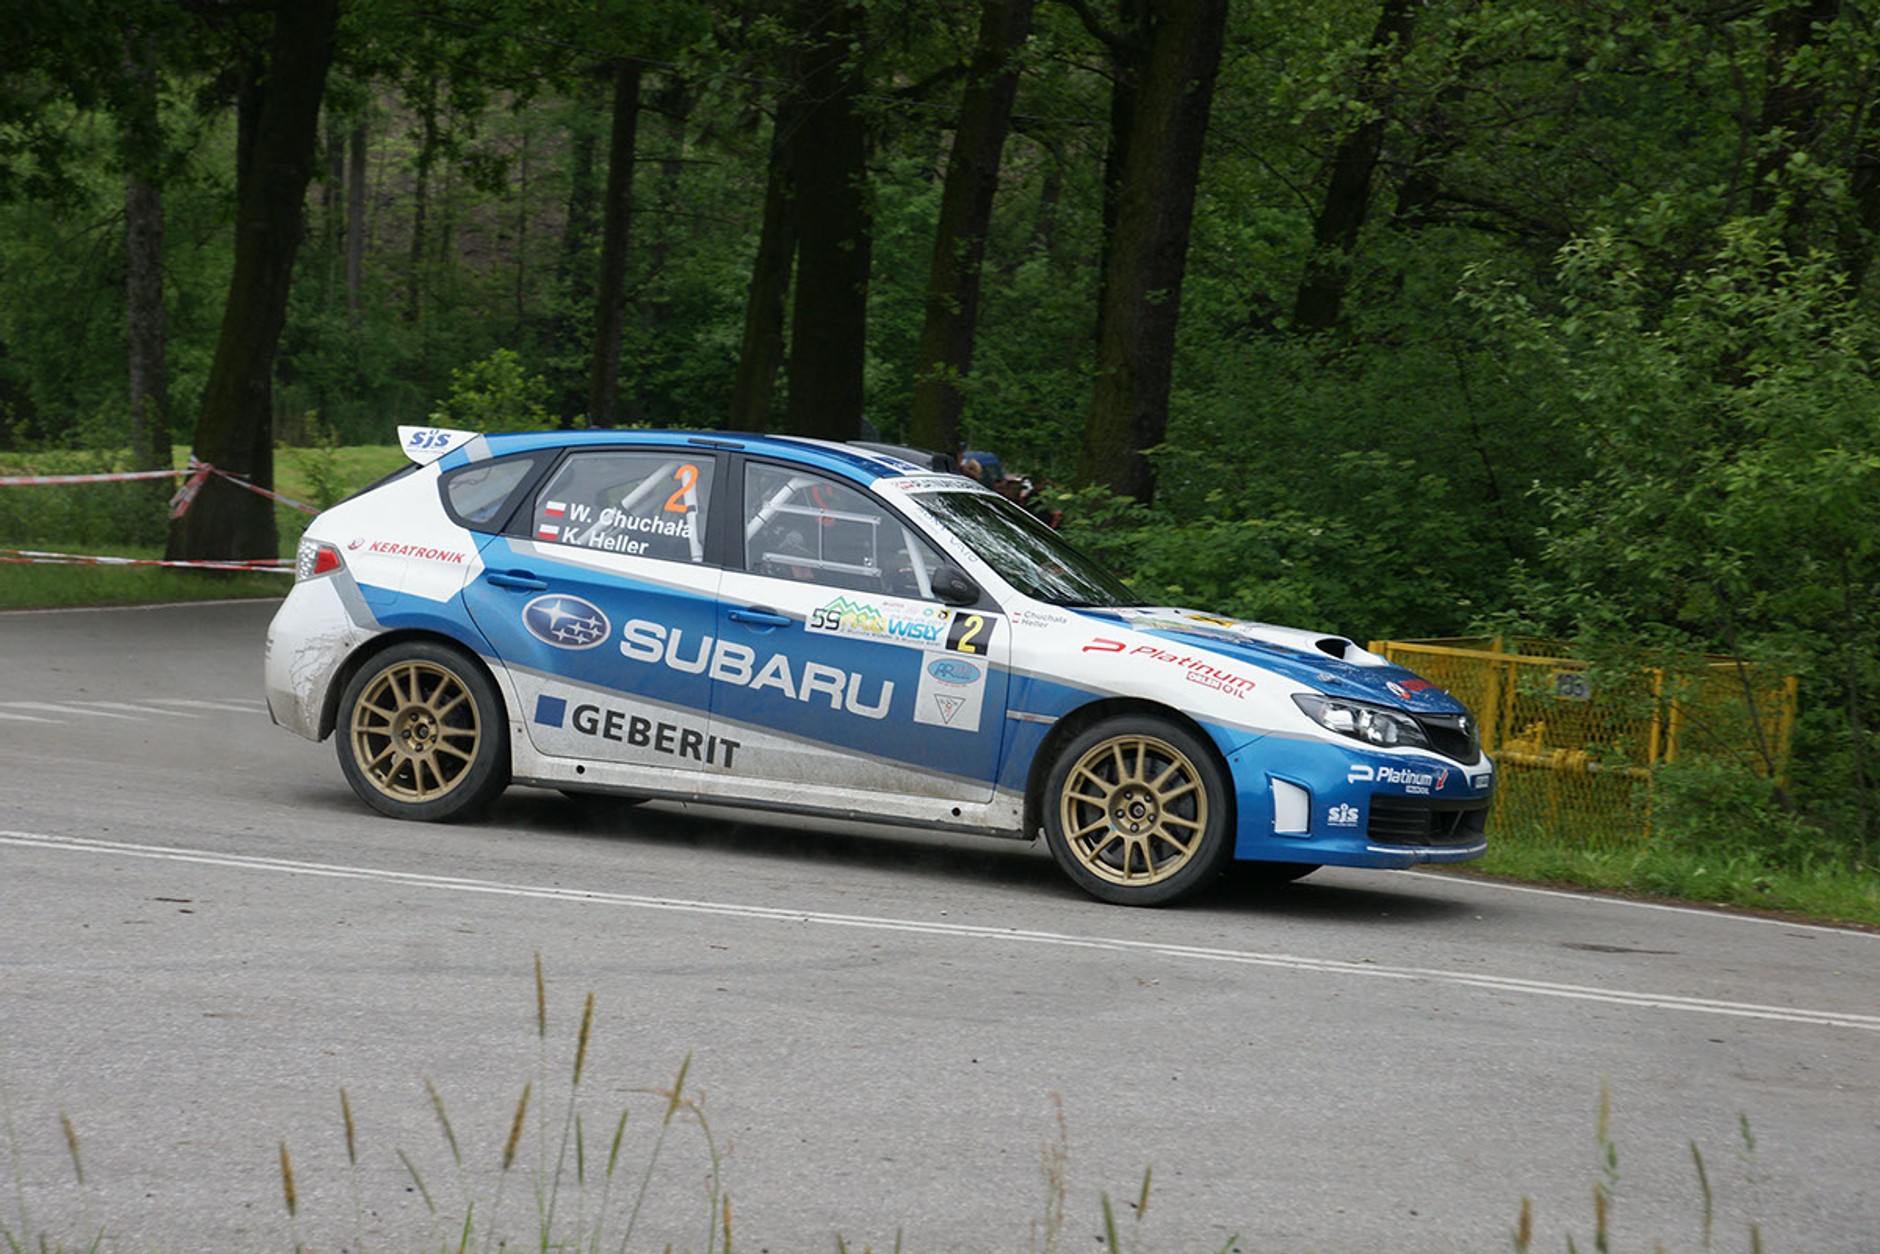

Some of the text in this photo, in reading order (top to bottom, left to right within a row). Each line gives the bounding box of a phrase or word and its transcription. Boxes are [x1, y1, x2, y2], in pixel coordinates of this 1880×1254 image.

[664, 464, 699, 513] 2
[570, 503, 691, 538] W. Chuchała
[369, 541, 466, 564] KERATRONIK
[562, 526, 650, 555] K. Heller
[810, 608, 841, 632] 59
[956, 615, 984, 653] 2
[620, 619, 895, 719] SUBARU
[1130, 645, 1256, 692] Platinum
[1222, 684, 1245, 700] OIL
[571, 703, 741, 768] GEBERIT
[1376, 766, 1433, 786] Platinum
